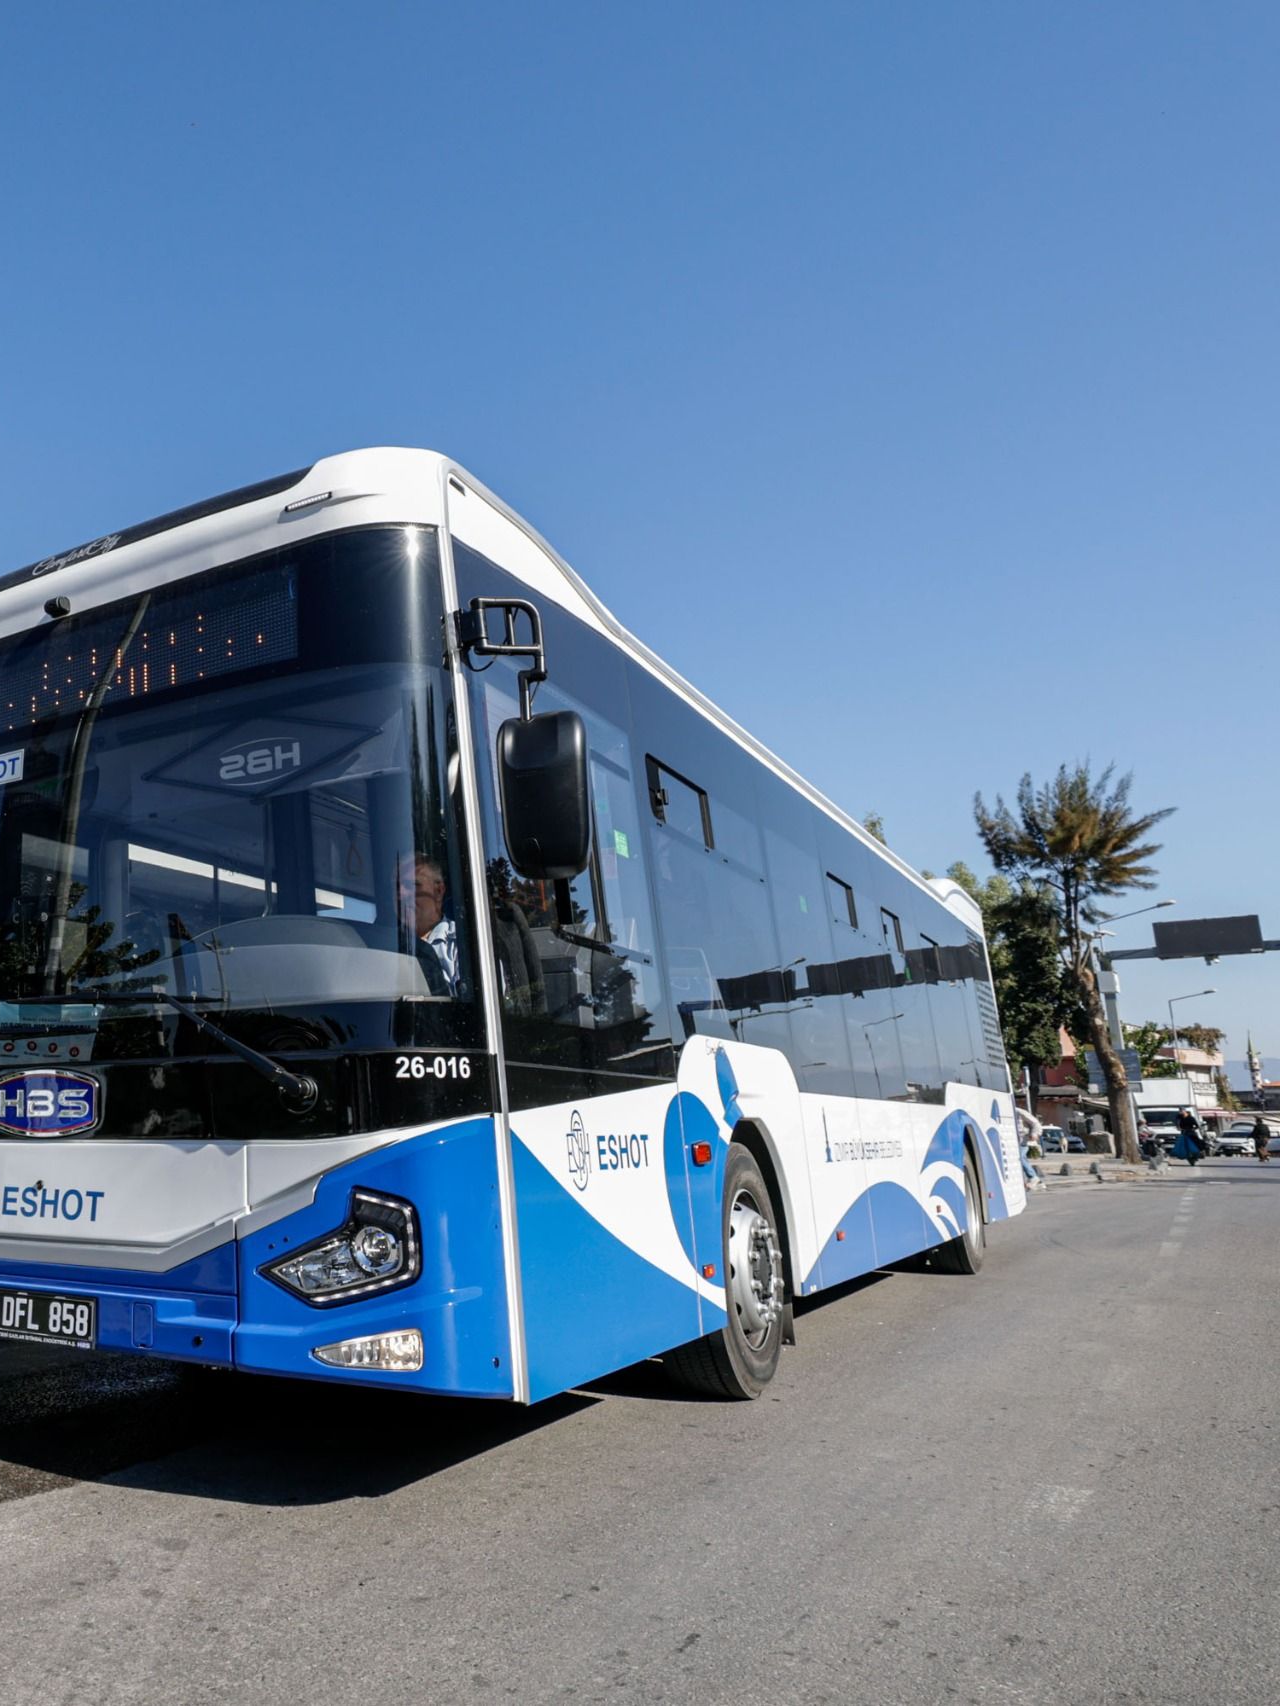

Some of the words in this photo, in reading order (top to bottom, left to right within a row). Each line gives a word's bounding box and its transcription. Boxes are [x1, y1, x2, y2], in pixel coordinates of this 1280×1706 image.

[395, 1056, 471, 1078] 26-016
[597, 1134, 648, 1170] ESHOT
[2, 1185, 105, 1221] ESHOT
[1, 1296, 39, 1330] DFL
[48, 1302, 89, 1336] 858
